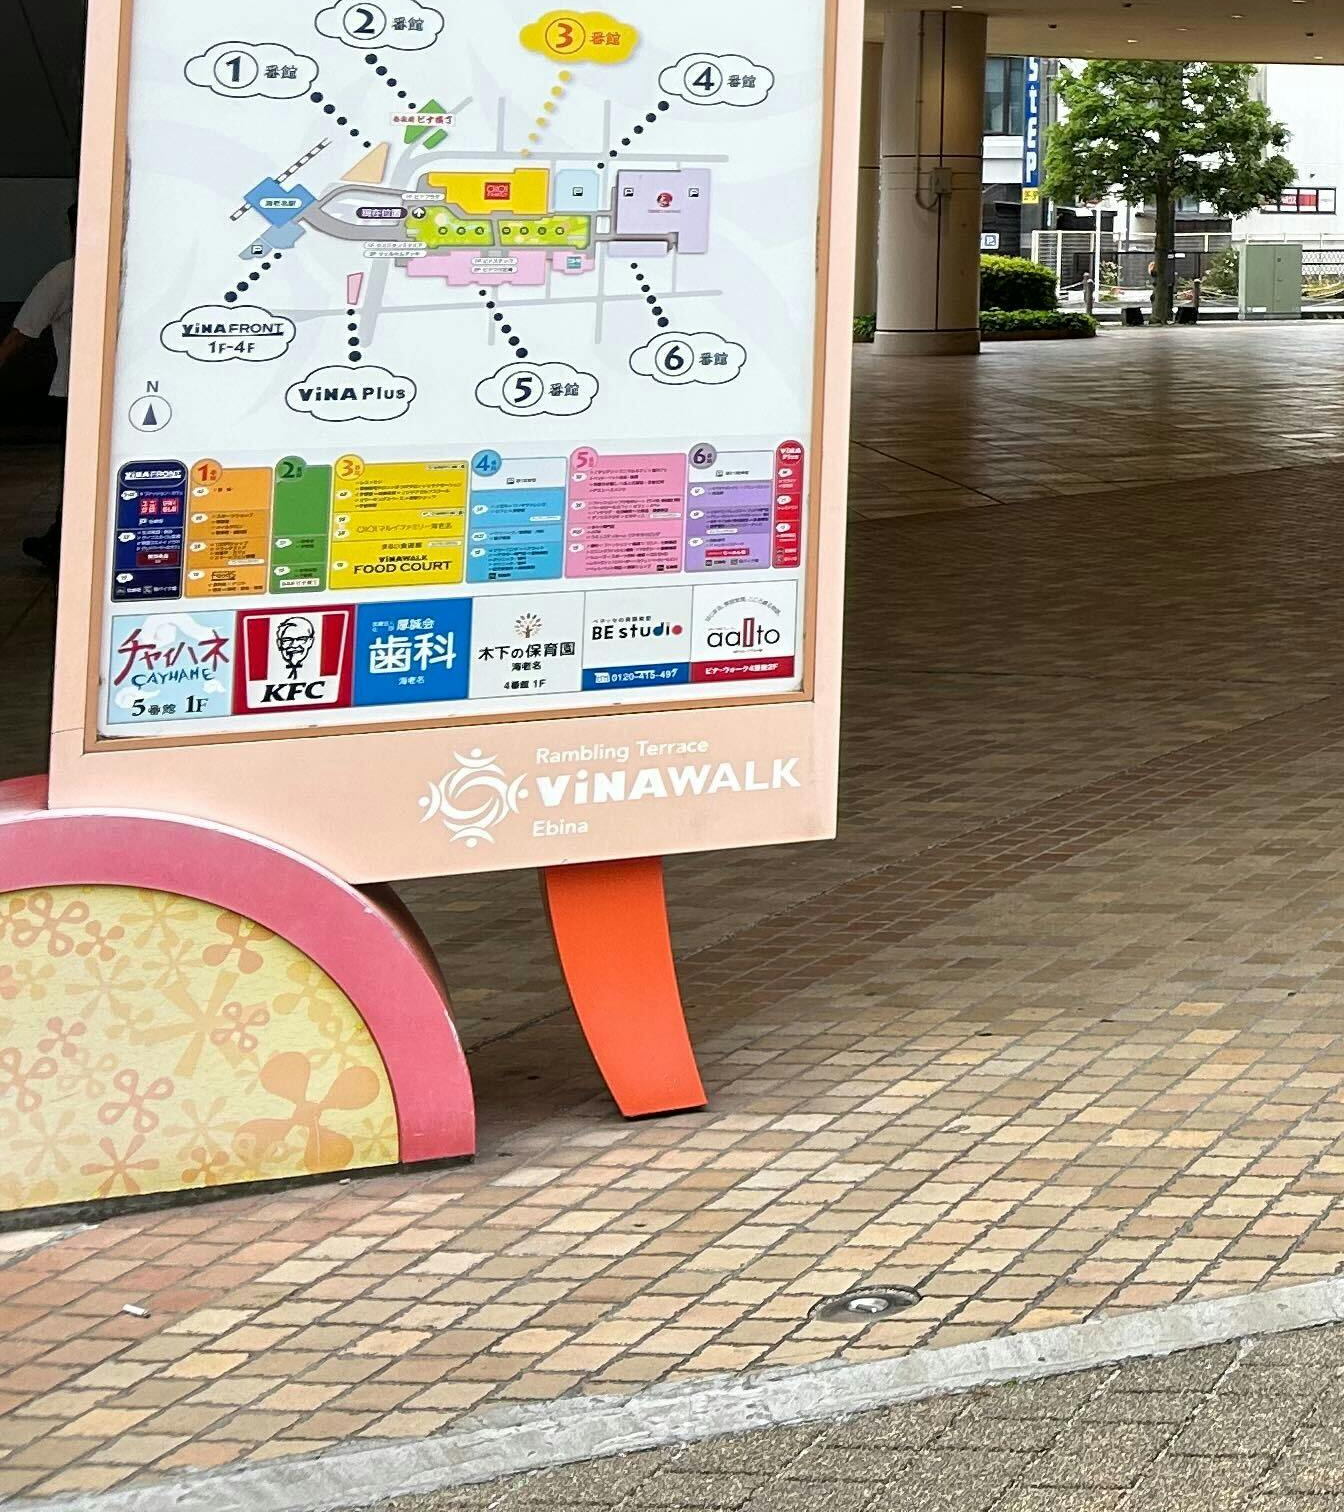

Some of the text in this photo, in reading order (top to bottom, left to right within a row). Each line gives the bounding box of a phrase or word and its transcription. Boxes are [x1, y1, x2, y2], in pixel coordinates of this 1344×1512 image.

[207, 341, 256, 355] 1F-4F
[146, 381, 160, 393] N
[297, 386, 406, 402] ViNA Plus
[353, 561, 452, 575] FOOD COURT
[592, 621, 683, 641] BE studio
[113, 629, 230, 686] チャイハネ
[369, 631, 457, 675] 歯科
[478, 641, 576, 661] 木下の保育園
[260, 680, 328, 703] KFC
[185, 695, 209, 713] 1F
[536, 738, 710, 764] Rambling Terrace
[536, 757, 801, 808] ViNAWALK
[532, 818, 589, 838] Ebina
